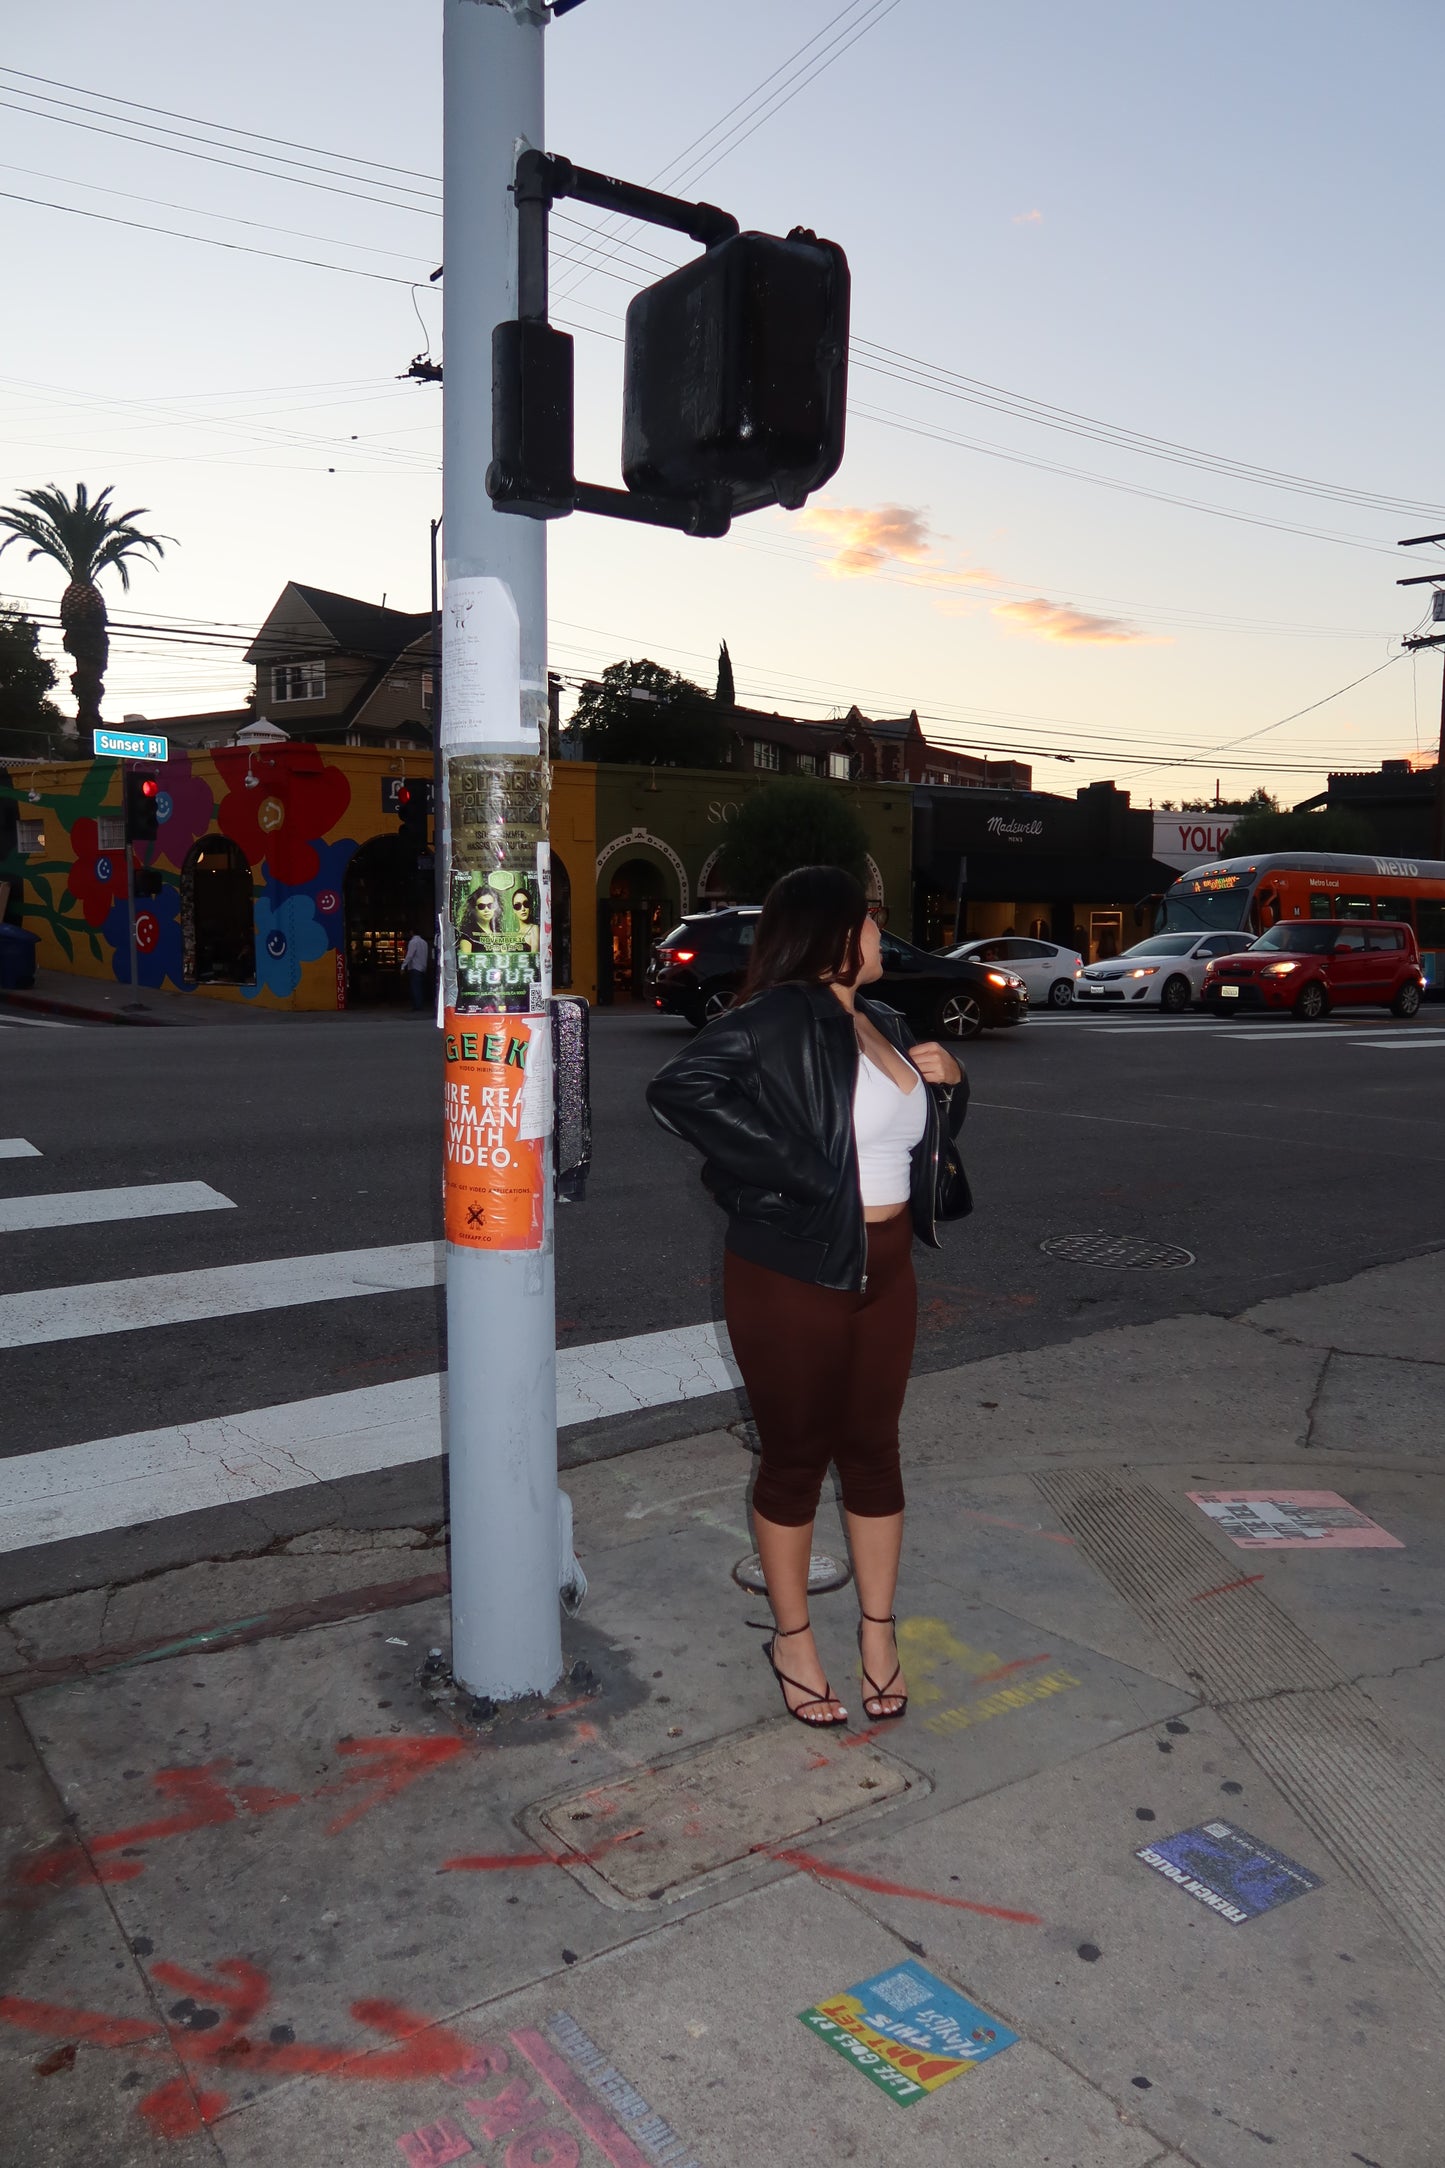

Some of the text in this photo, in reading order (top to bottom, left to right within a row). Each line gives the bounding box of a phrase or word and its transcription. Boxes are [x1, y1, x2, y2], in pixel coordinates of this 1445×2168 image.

[100, 735, 162, 754] Sunset Bl
[987, 816, 1044, 836] Madewell
[1178, 826, 1229, 852] YOLK
[1373, 859, 1419, 877] Metro
[1309, 878, 1340, 888] Metro Local
[467, 968, 535, 984] HOUR
[445, 1032, 529, 1070] GEEK
[445, 1105, 517, 1127] HUMAN
[449, 1126, 503, 1147] WITH
[447, 1145, 519, 1167] VIDEO.
[1136, 1848, 1248, 1923] FRENCH POLICE
[822, 2005, 866, 2033] LET
[865, 2013, 933, 2049] THIS
[833, 2033, 880, 2065] GOES
